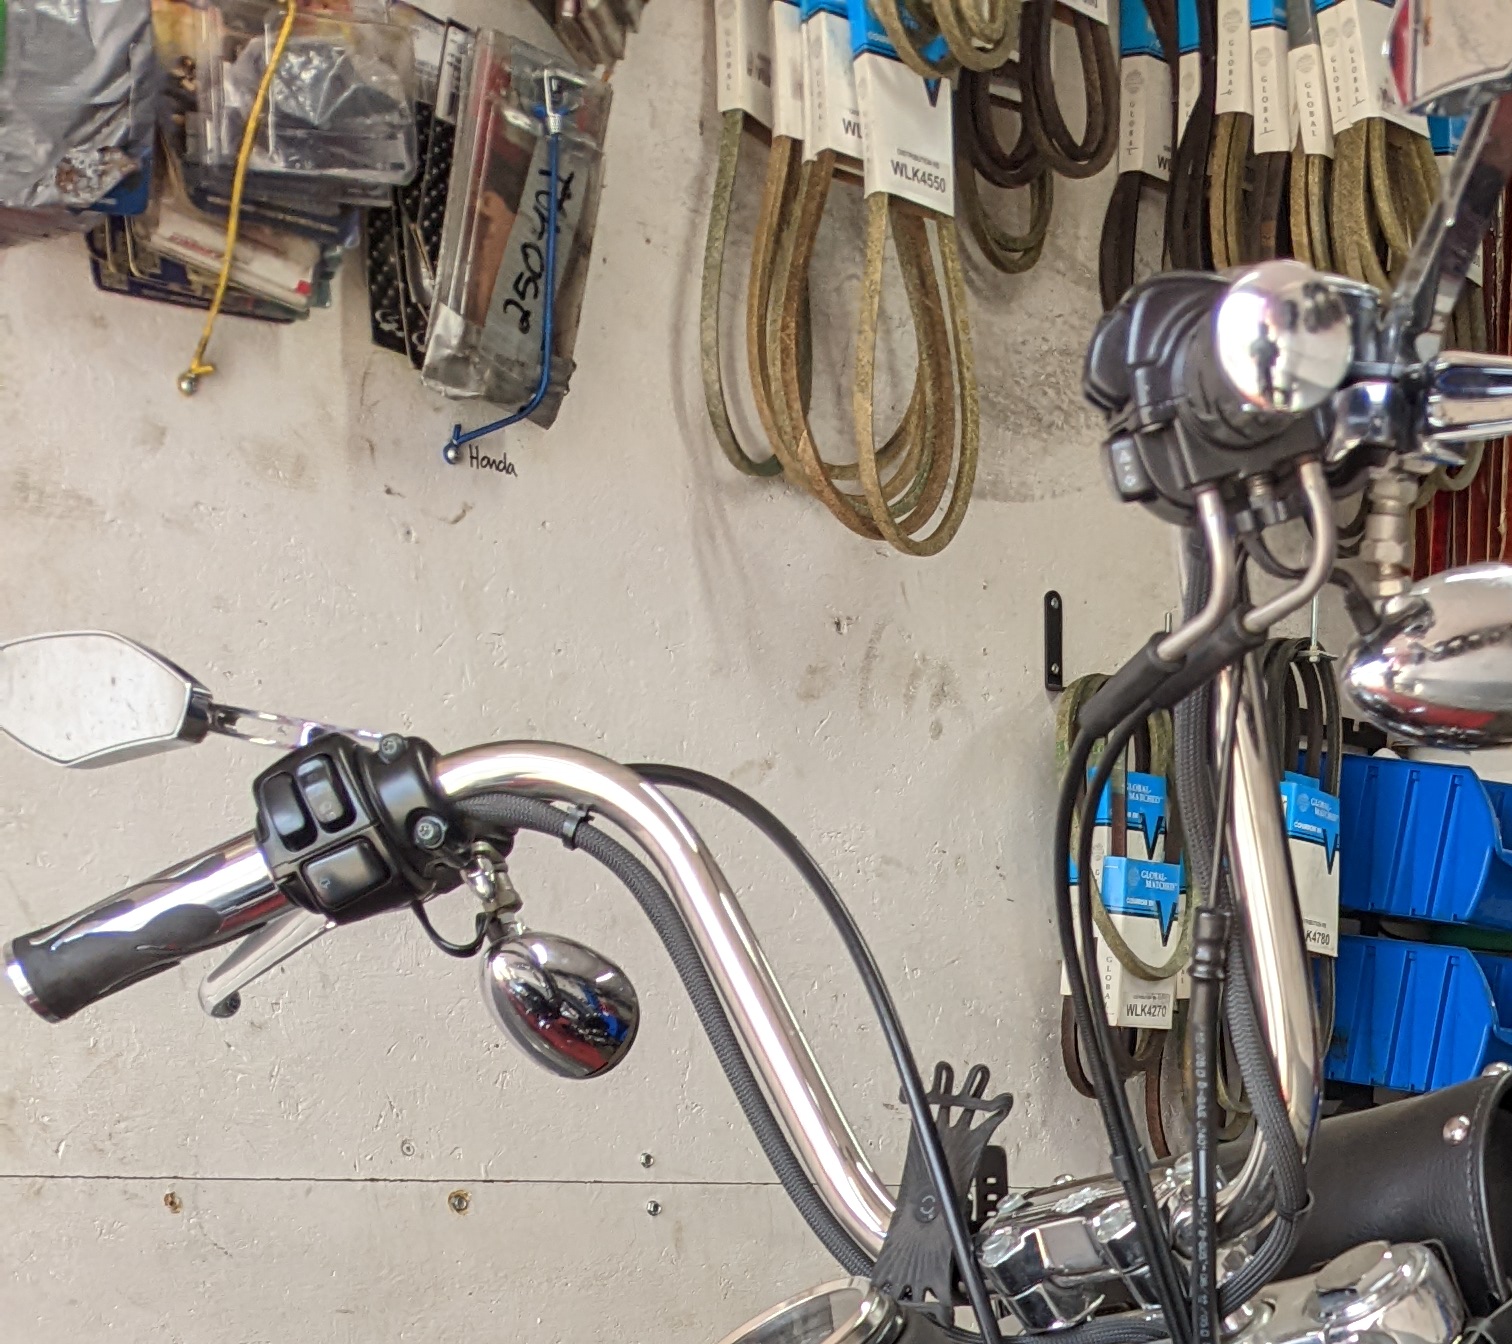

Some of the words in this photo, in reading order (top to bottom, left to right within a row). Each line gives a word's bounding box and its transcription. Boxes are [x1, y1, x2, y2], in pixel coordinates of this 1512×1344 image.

[1330, 56, 1343, 113] GLOBAL
[1260, 75, 1270, 134] GLOBAL
[1304, 82, 1318, 138] GLOBAL
[890, 159, 946, 193] WLK4550
[469, 445, 519, 478] Honda
[1305, 929, 1331, 946] K4780
[1125, 1002, 1167, 1018] WLK4270
